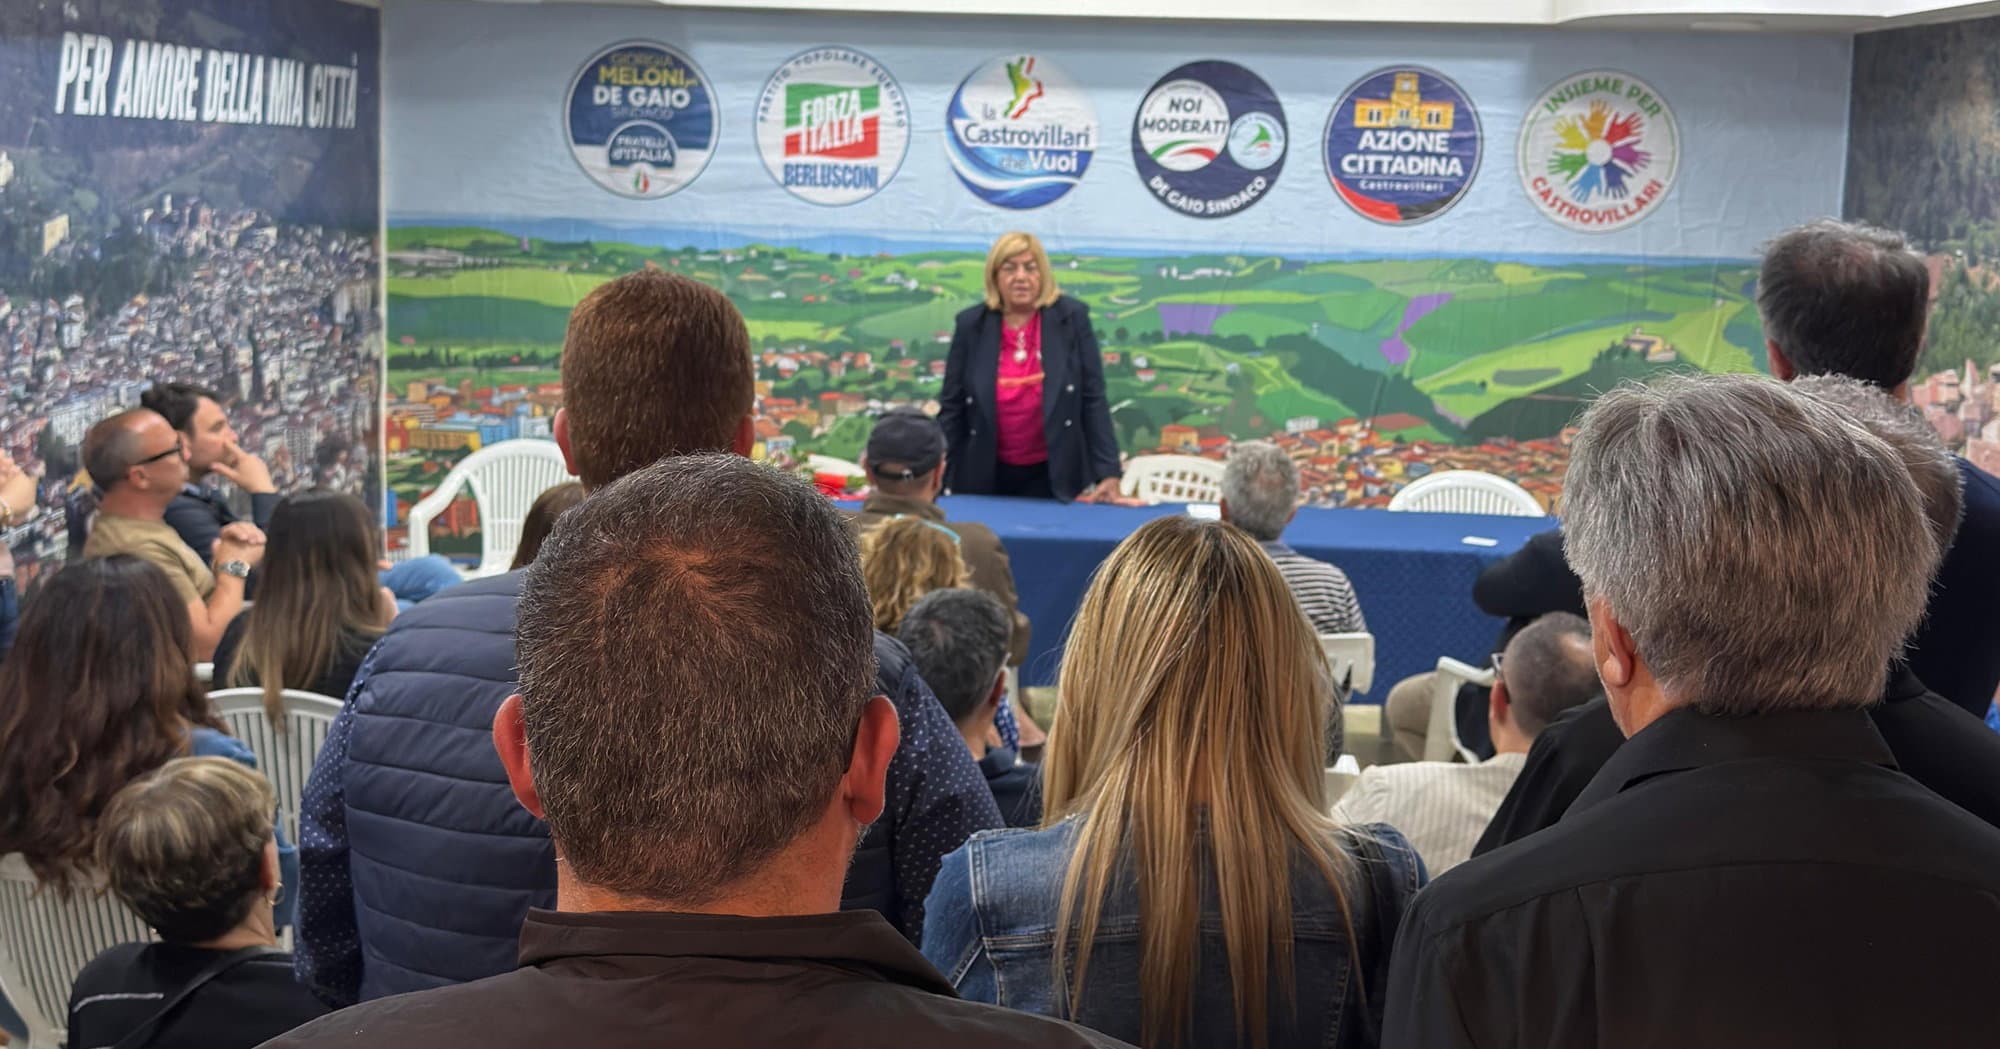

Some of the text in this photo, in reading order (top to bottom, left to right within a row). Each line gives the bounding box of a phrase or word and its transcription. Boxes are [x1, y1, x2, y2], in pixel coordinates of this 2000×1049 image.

[55, 31, 113, 116] PER
[112, 38, 202, 122] AMORE
[203, 49, 265, 124] DELLA
[266, 57, 305, 128] MIA
[599, 66, 685, 87] MELONI
[593, 85, 691, 109] DE GAIO
[801, 89, 861, 126] FORZA
[1168, 98, 1202, 113] NOI
[1544, 77, 1662, 118] INSIEME PER
[982, 103, 997, 120] la
[801, 116, 865, 155] ITALIA
[964, 123, 1091, 146] Castrovillari
[1142, 118, 1228, 135] MODERATI
[1357, 130, 1450, 152] AZIONE
[1028, 150, 1078, 172] Vuoi
[1341, 154, 1464, 177] CITTADINA
[784, 164, 879, 189] BERLUSCONI
[1359, 180, 1444, 193] Castrovillari
[1150, 175, 1267, 214] DE GAIO SINDACO
[1532, 176, 1663, 224] CASTROVILLARI
